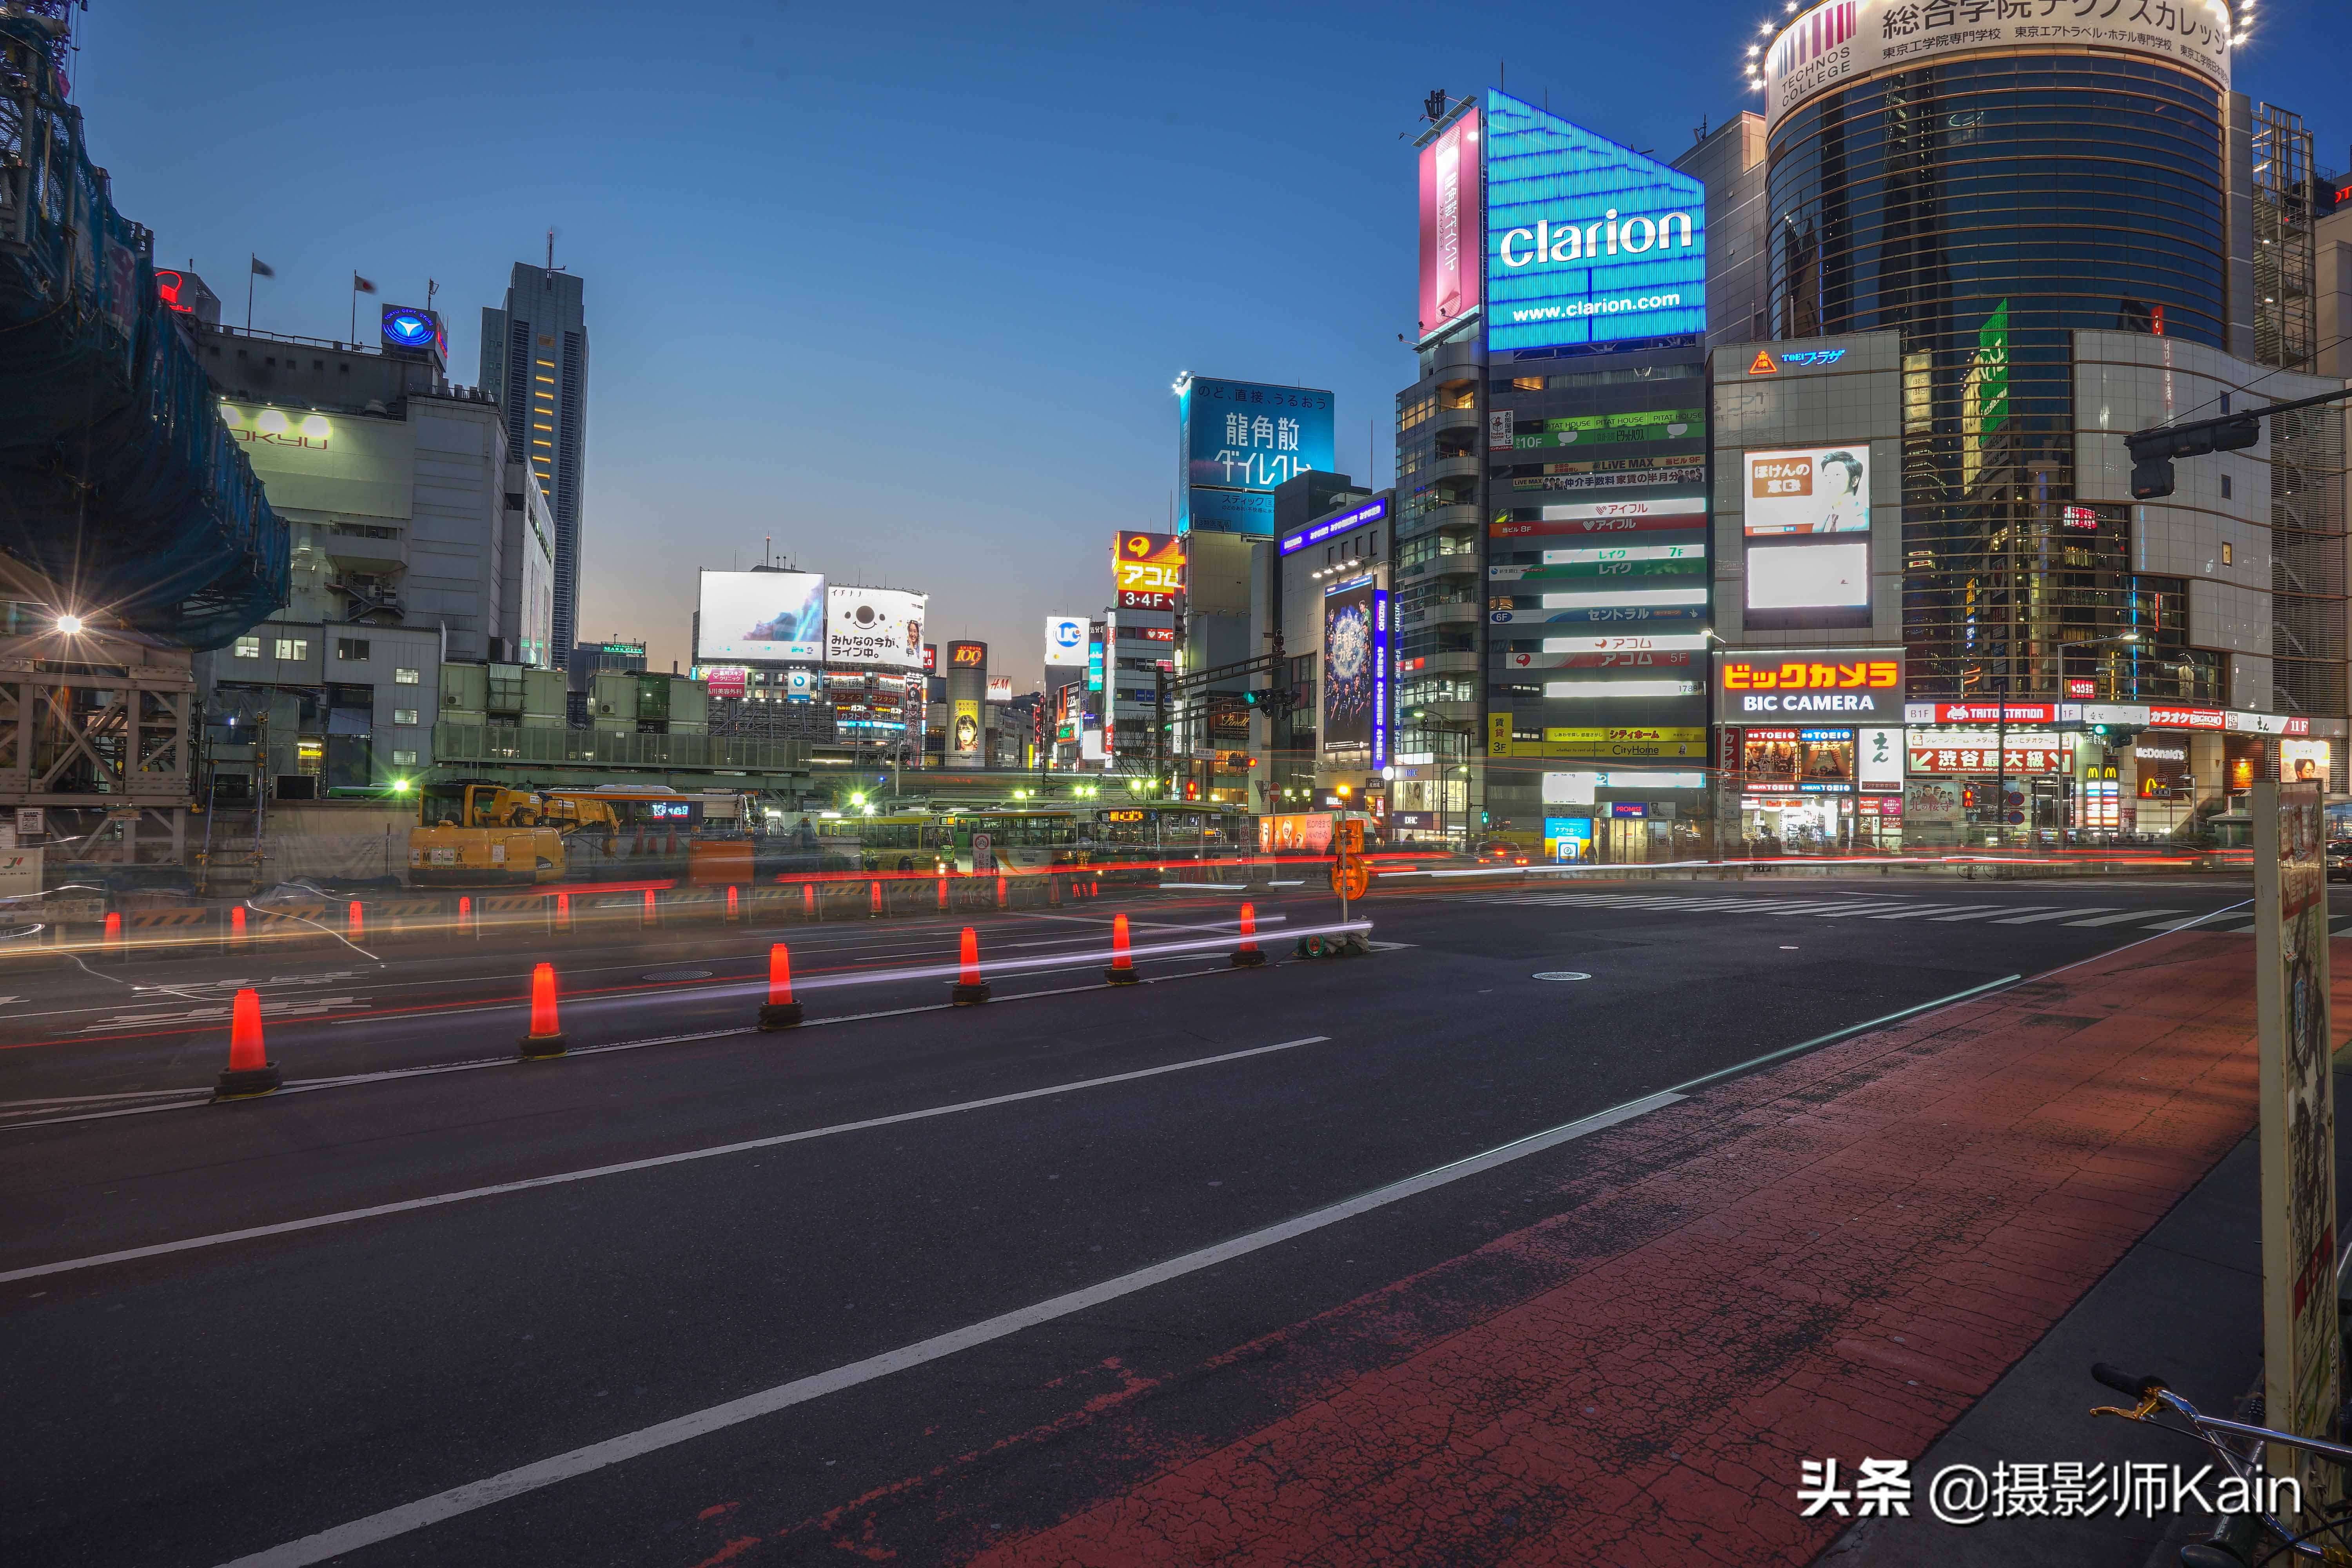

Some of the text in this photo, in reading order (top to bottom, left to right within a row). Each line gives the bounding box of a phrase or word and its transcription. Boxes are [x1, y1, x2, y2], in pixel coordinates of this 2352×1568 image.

[1882, 28, 2001, 60] 東京工学院専門学校
[1782, 47, 1851, 91] TECHNOS
[1782, 60, 1851, 107] COLLEGE
[1500, 209, 1692, 268] clarion
[1513, 292, 1680, 322] www.clarion.com
[1198, 385, 1327, 409] のど、直接、うるおう
[1226, 412, 1300, 451] 龍角散
[1544, 422, 1563, 430] PITAT
[1521, 436, 1542, 448] 10F
[1628, 458, 1654, 468] MAX
[1665, 457, 1687, 465] 当ビル
[1755, 464, 1810, 479] ほけんの
[1564, 472, 1679, 487] 仲介手数料 家賃の半月分
[1608, 503, 1648, 514] アイフル
[1595, 518, 1636, 530] アイフル
[1599, 547, 1684, 559] レイク 7F
[1599, 561, 1632, 574] レイク
[1124, 565, 1181, 588] アコム
[1496, 613, 1508, 621] 6F
[1588, 608, 1650, 621] セントラル
[831, 635, 899, 649] みんなの今が、
[1613, 637, 1652, 649] アコム
[831, 646, 879, 659] ライブ中。
[954, 650, 982, 665] 109
[1601, 652, 1687, 666] アコム 5F
[1724, 662, 1897, 689] ビックカメラ
[991, 678, 1009, 690] H&M
[1744, 695, 1875, 711] BIC CAMERA
[841, 712, 860, 720] ガスト
[1911, 710, 1929, 718] B1F
[1970, 708, 1999, 719] TAITO
[2151, 711, 2188, 724] カラオケ
[1219, 715, 1250, 727] Lindt
[2290, 718, 2308, 732] 11F
[1609, 730, 1659, 739] シティホーム
[1493, 742, 1506, 751] 3F
[1938, 750, 2045, 768] 渋谷最大級
[1405, 768, 1418, 777] DHC
[1909, 802, 1952, 812] 北の桜守
[1405, 816, 1418, 824] DHC
